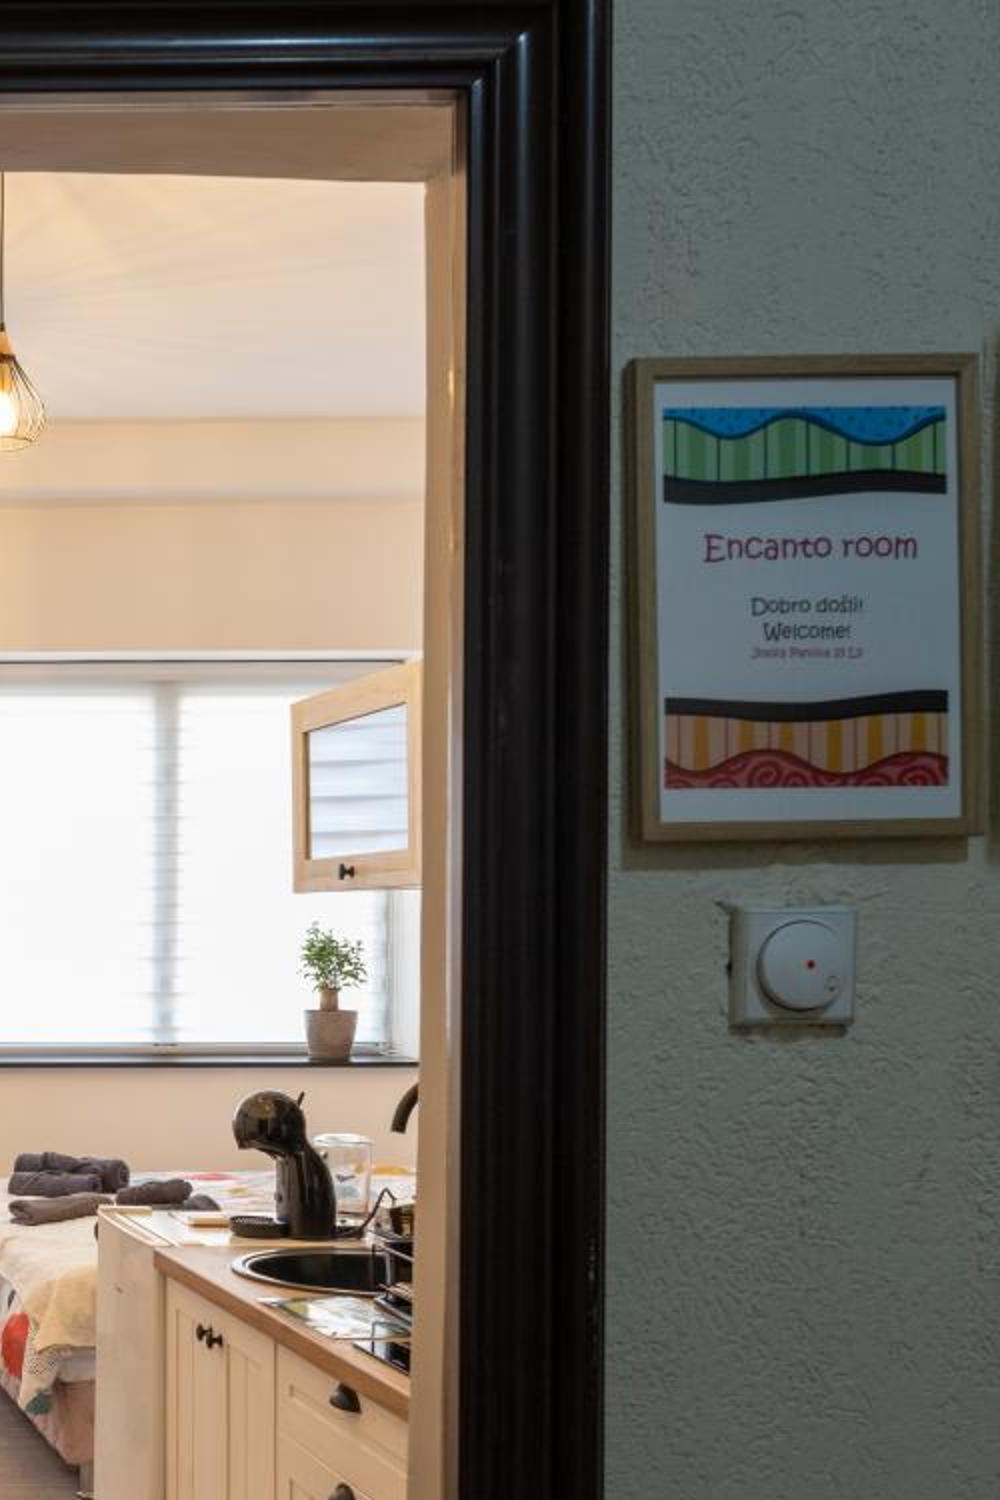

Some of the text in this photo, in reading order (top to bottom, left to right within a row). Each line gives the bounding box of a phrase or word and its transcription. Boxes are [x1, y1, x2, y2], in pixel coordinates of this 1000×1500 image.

[703, 534, 918, 563] Encanto room
[751, 597, 811, 616] Dobro
